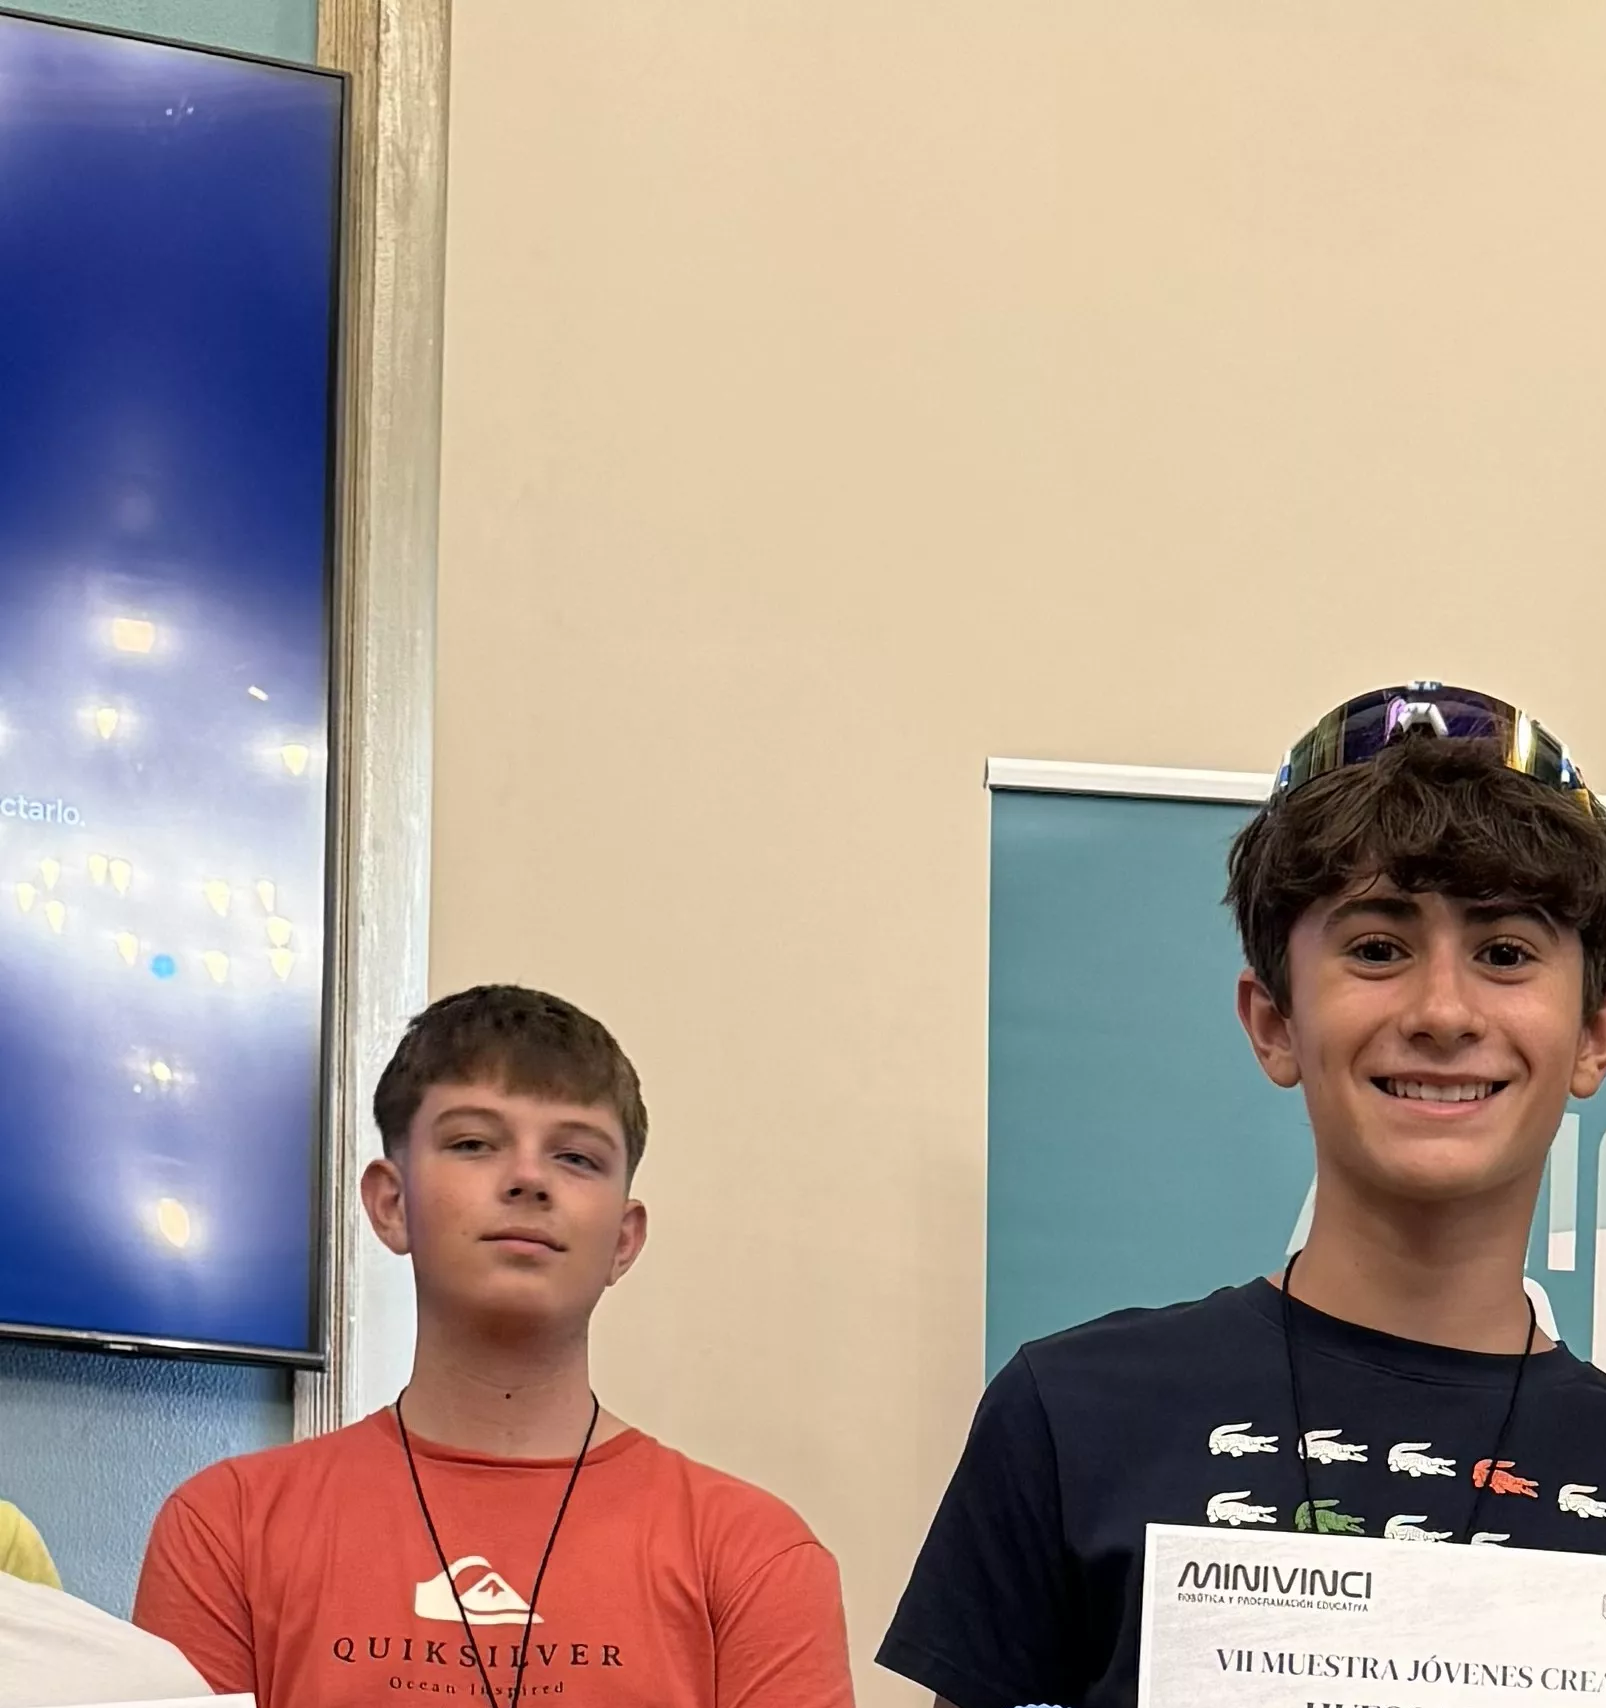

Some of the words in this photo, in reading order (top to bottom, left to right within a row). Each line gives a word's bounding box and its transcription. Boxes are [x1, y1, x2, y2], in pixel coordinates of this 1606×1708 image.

[1177, 1561, 1372, 1599] MINIVINCI
[333, 1636, 624, 1668] QUIKSILVER
[1217, 1648, 1253, 1673] VII
[1262, 1651, 1399, 1681] MUESTRA
[1407, 1655, 1533, 1689] JÓVENES
[389, 1676, 456, 1694] Ocean
